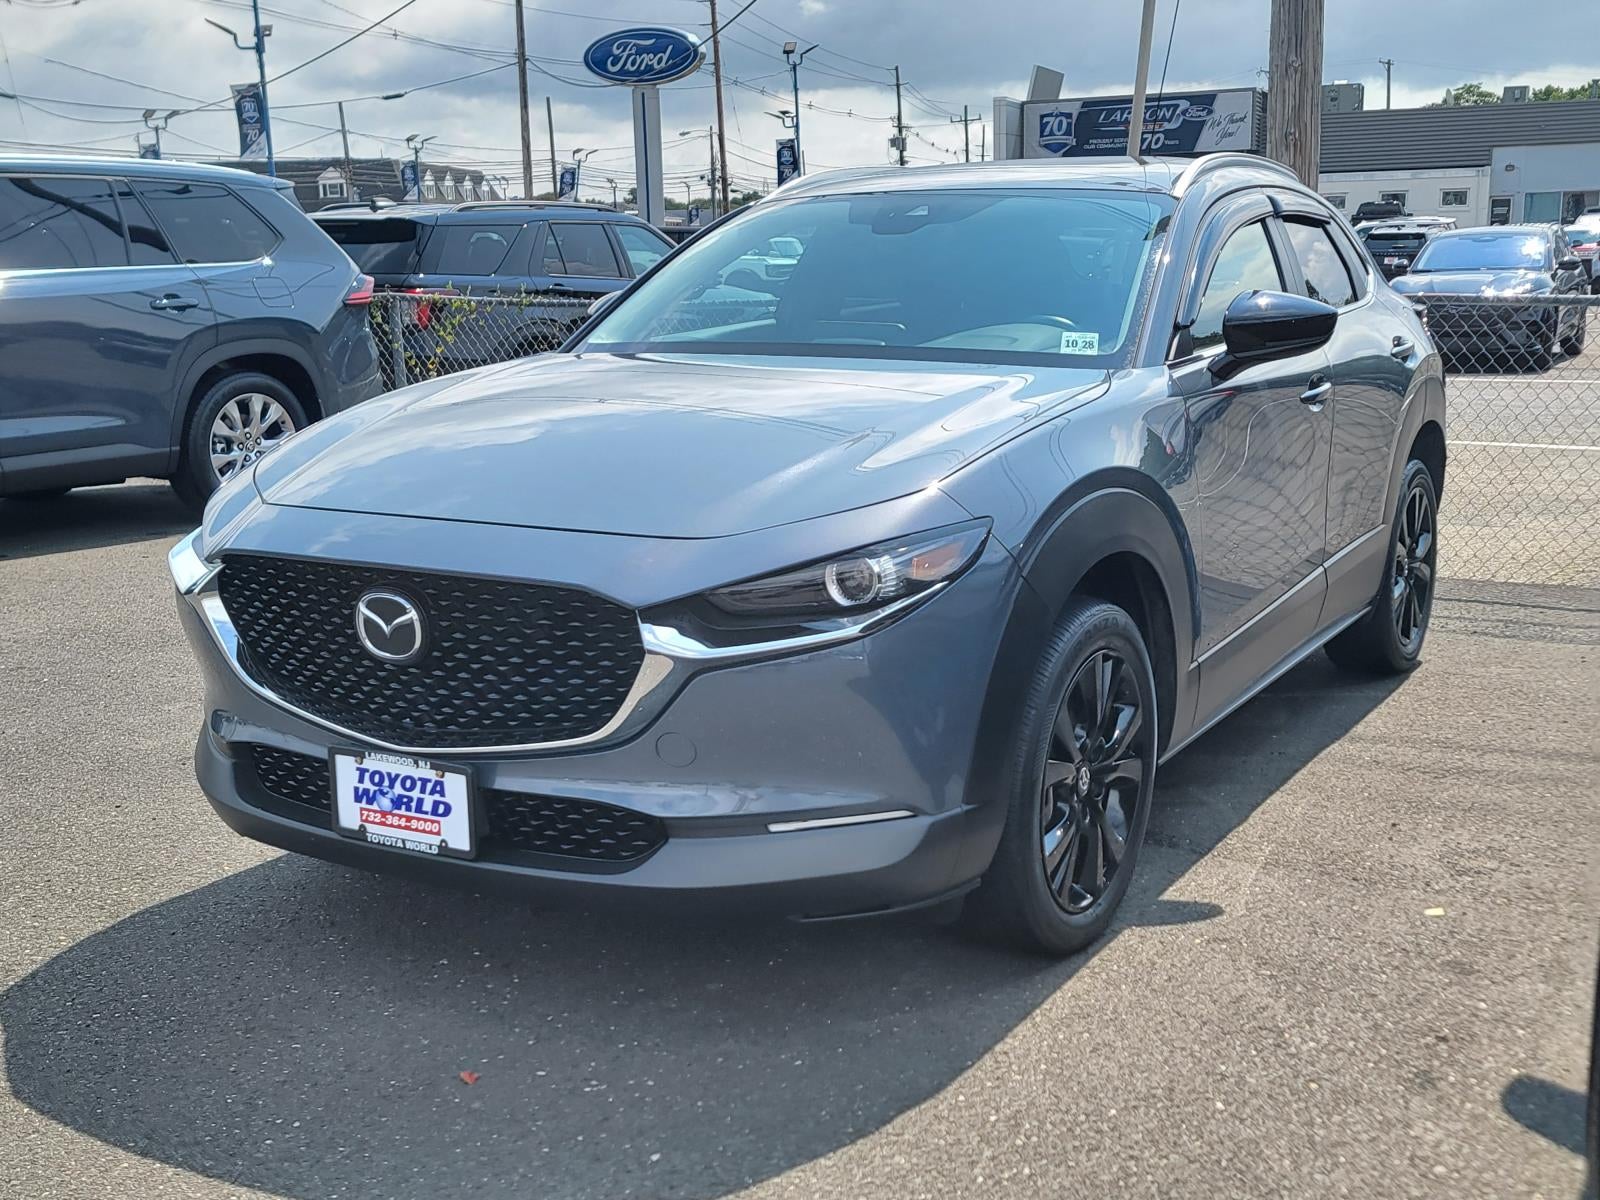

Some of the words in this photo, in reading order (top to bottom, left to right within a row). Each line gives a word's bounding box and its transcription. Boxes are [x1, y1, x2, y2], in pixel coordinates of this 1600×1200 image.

[607, 38, 674, 73] Ford
[1098, 107, 1174, 123] LARON
[1185, 107, 1209, 117] Ford
[1042, 116, 1068, 136] 70
[246, 128, 260, 145] 70
[1141, 133, 1165, 150] 70
[1065, 339, 1078, 348] 10
[1082, 340, 1095, 350] 28
[365, 751, 417, 769] LAKEWOOD,
[418, 761, 431, 769] NJ
[355, 766, 446, 798] TOYOTA
[353, 786, 453, 818] WORLD
[361, 810, 440, 833] 732-364-9000
[366, 833, 404, 848] TOYOTA
[405, 840, 439, 854] WORLD
